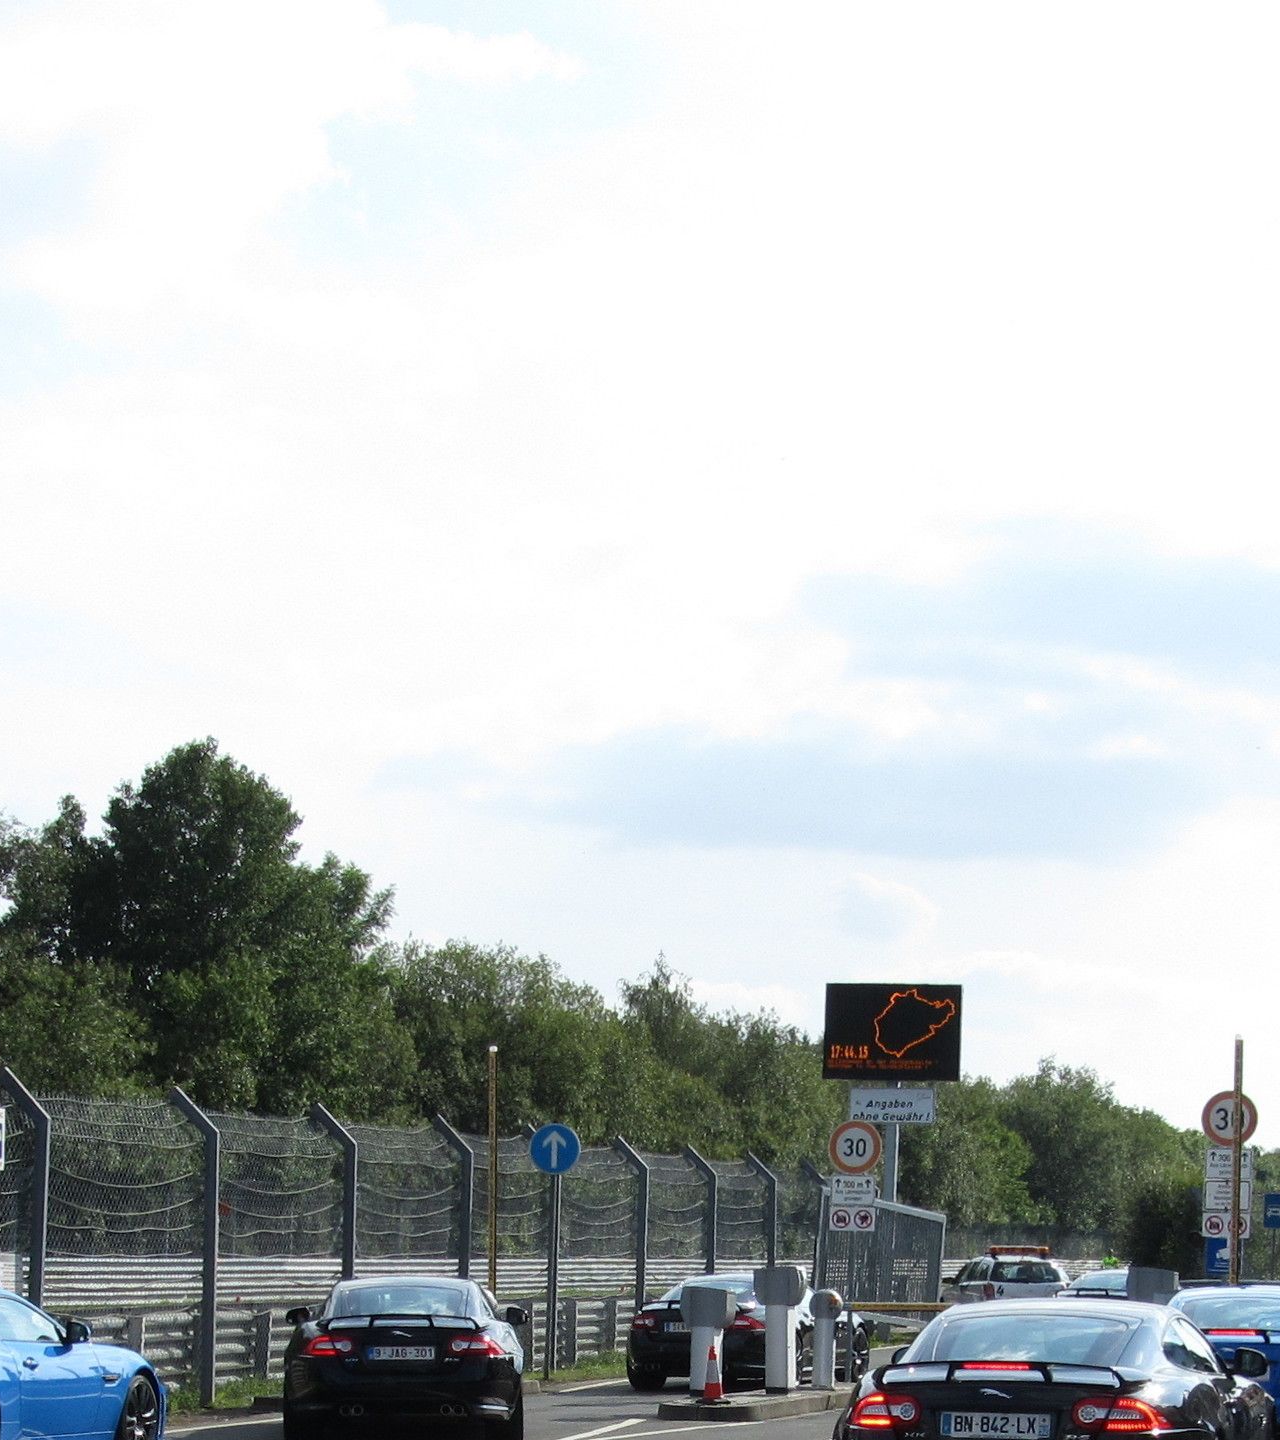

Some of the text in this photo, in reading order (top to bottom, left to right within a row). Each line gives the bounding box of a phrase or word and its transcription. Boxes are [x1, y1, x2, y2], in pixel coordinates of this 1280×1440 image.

[866, 1100, 913, 1110] Angaben
[852, 1112, 879, 1121] ohne
[1215, 1108, 1244, 1130] 30
[843, 1138, 867, 1157] 30
[953, 1415, 1037, 1434] BN-842-LX
